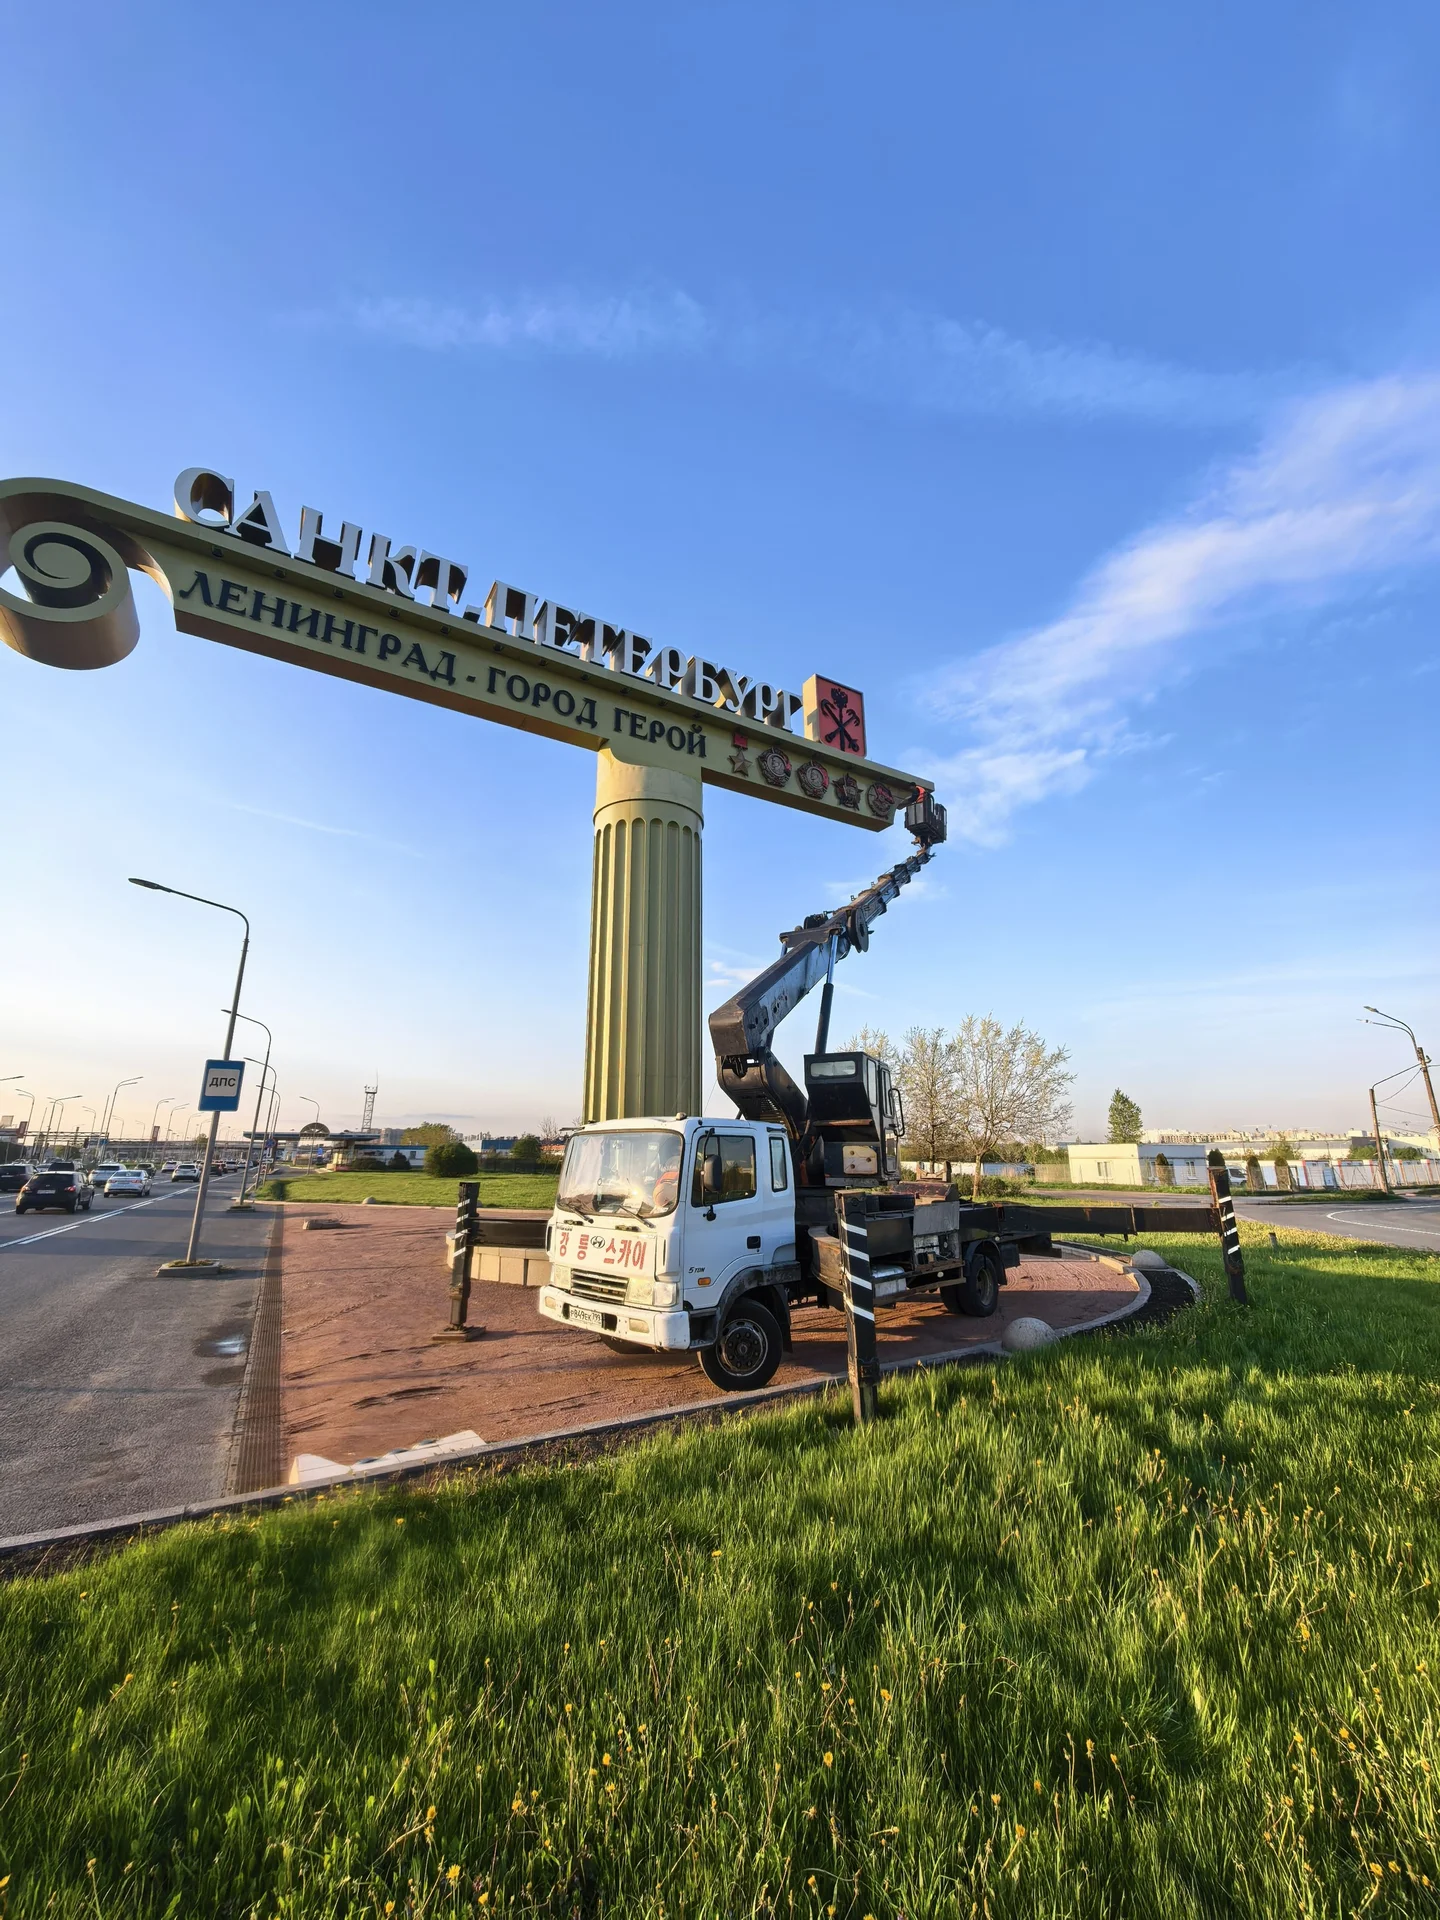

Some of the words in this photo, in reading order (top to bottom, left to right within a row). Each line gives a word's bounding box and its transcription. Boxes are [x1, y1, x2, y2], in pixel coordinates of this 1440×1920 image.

[174, 467, 803, 732] САНКТ-ПЕТЕРБУРГ
[178, 571, 457, 687] ЛЕНИНГРАД
[487, 666, 598, 729] ГОРОД
[614, 706, 707, 758] ГЕРОЙ
[208, 1077, 236, 1087] ДПС
[603, 1238, 647, 1270] 스카이
